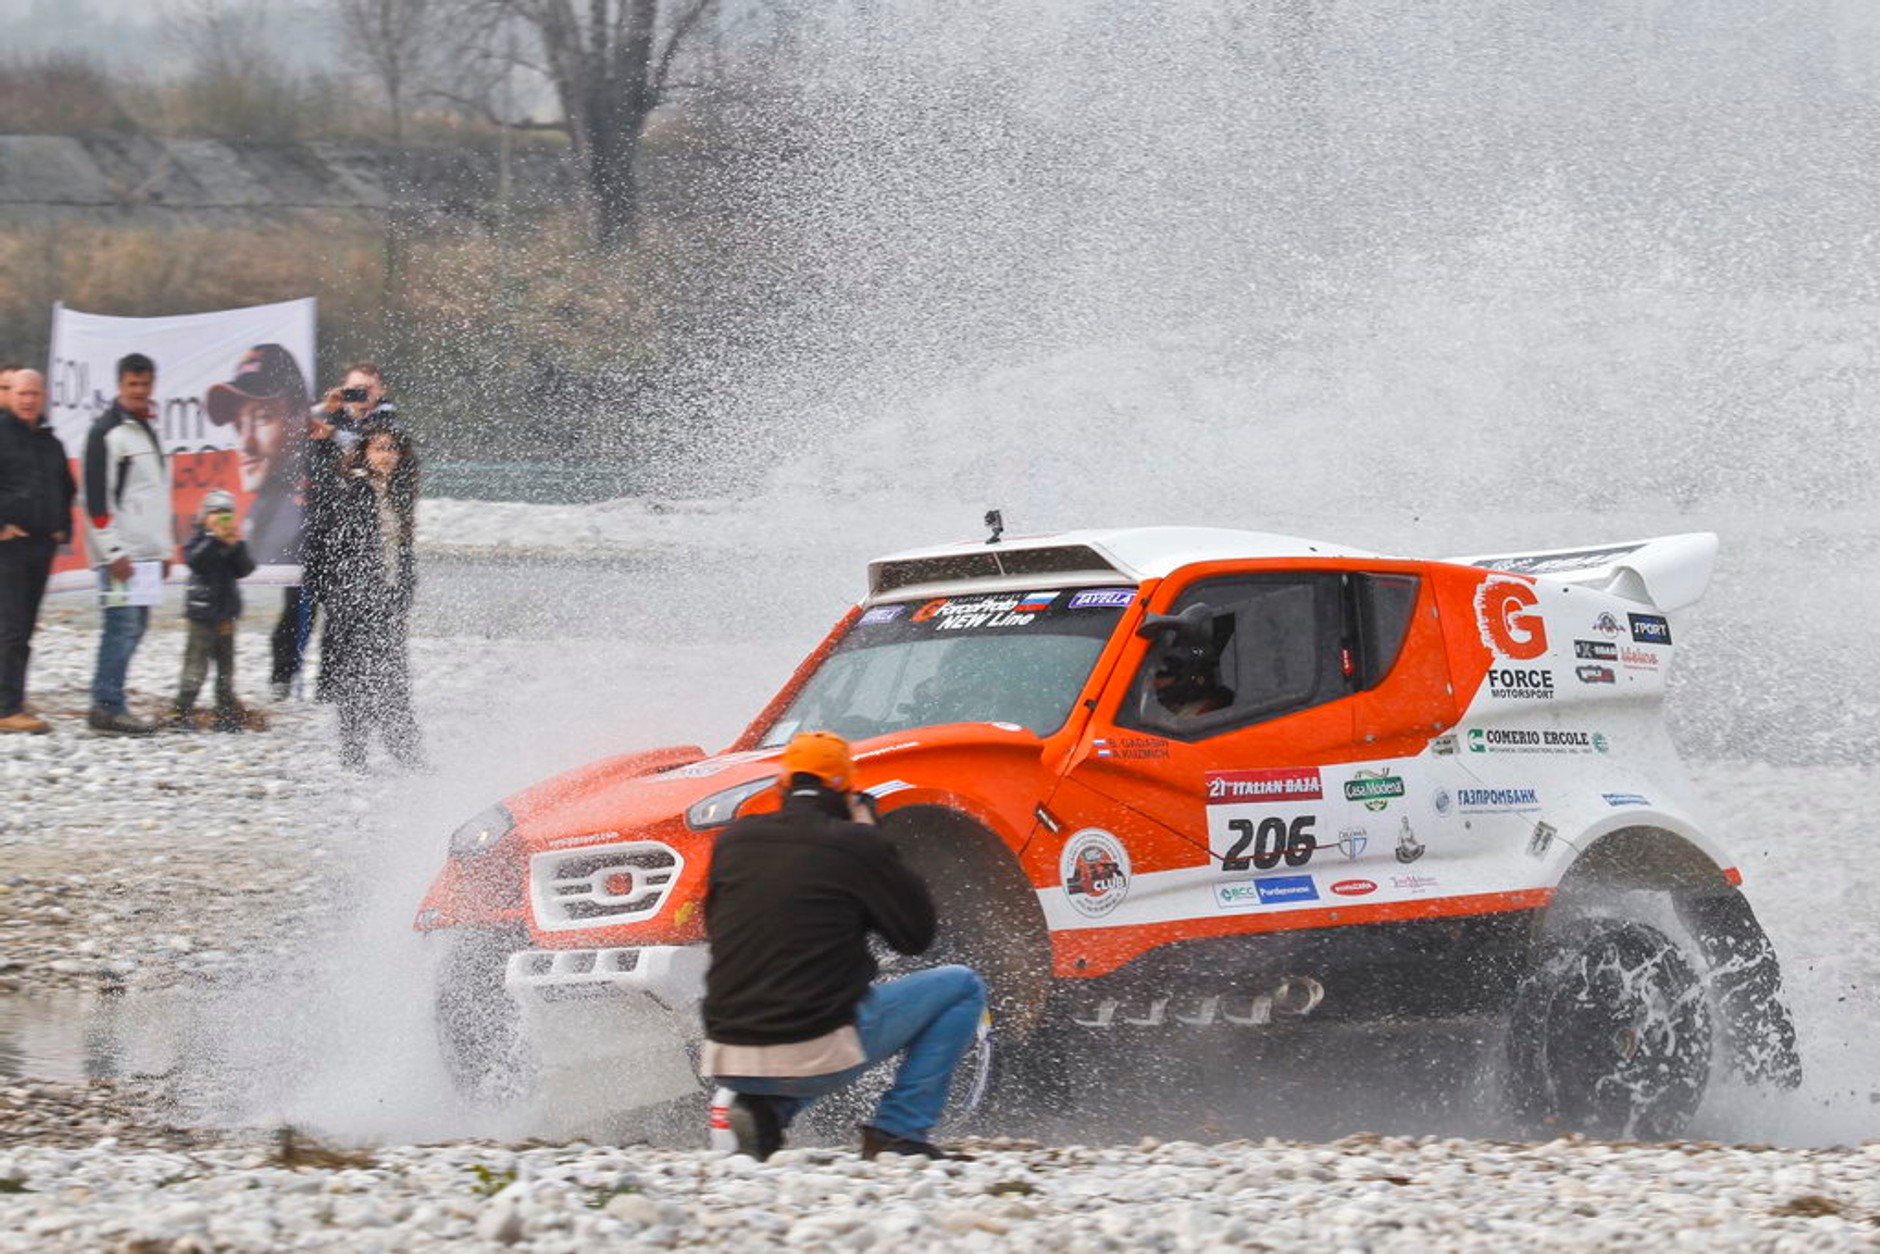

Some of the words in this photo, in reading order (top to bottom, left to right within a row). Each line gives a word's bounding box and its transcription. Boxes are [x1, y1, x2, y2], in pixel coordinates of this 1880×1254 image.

[936, 613, 991, 631] NEW
[987, 611, 1035, 628] Line
[1634, 622, 1667, 637] SPORT
[1488, 669, 1554, 689] FORCE
[1491, 688, 1554, 699] MOTORSPORT
[1487, 729, 1540, 745] COMERIO
[1543, 731, 1589, 746] ERCOLE
[1233, 779, 1283, 796] ITALIAN
[1286, 776, 1321, 793] BAJA
[1458, 788, 1539, 805] ГАЗПРОМБАНК
[1222, 815, 1317, 871] 206
